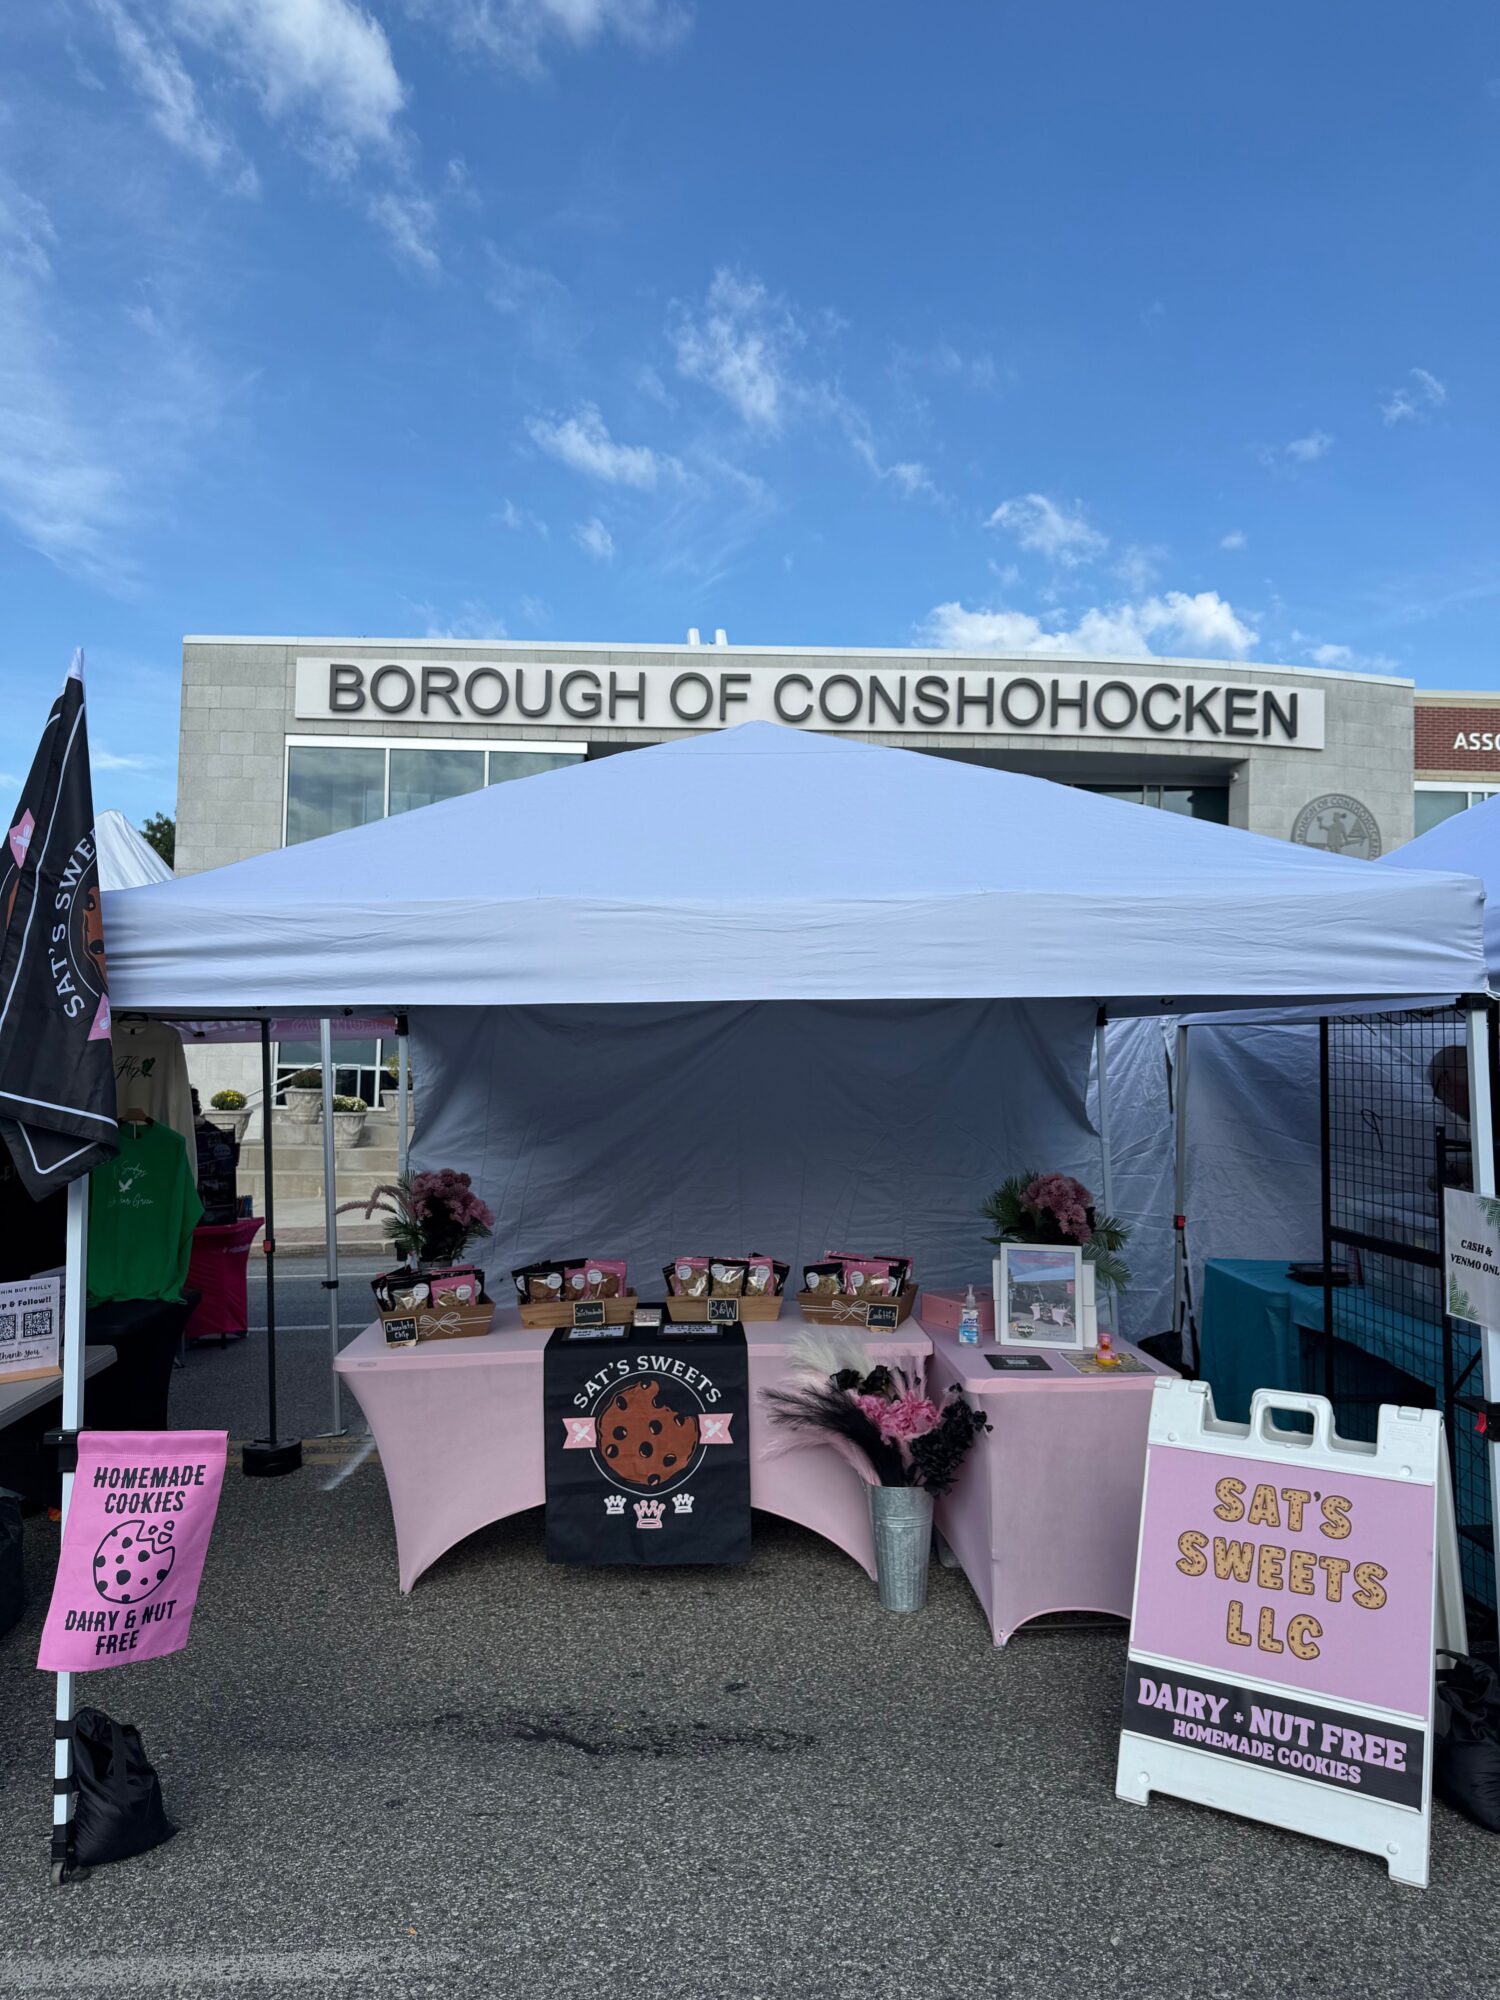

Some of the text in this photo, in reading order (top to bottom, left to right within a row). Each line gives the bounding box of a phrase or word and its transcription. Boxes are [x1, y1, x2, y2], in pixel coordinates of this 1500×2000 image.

[329, 663, 1299, 739] BOROUGH OF CONSHOHOCKEN
[1451, 1253, 1481, 1270] VENMO
[1461, 1240, 1493, 1257] CASH &
[18, 1296, 51, 1306] Follow!!
[710, 1300, 736, 1318] B&W
[573, 1355, 722, 1409] SAT'S SWEETS
[93, 1464, 207, 1489] HOMEMADE
[104, 1491, 185, 1514] COOKIES
[1213, 1477, 1353, 1540] SAT'S
[1175, 1530, 1388, 1610] SWEETS
[64, 1600, 178, 1632] DAIRY & NUT
[1226, 1600, 1323, 1660] LLC
[95, 1630, 139, 1656] FREE
[1137, 1678, 1229, 1725] DAIRY
[1248, 1708, 1316, 1748] NUT
[1320, 1724, 1408, 1772] FREE
[1173, 1719, 1362, 1785] HOMEMADE COOKIES
